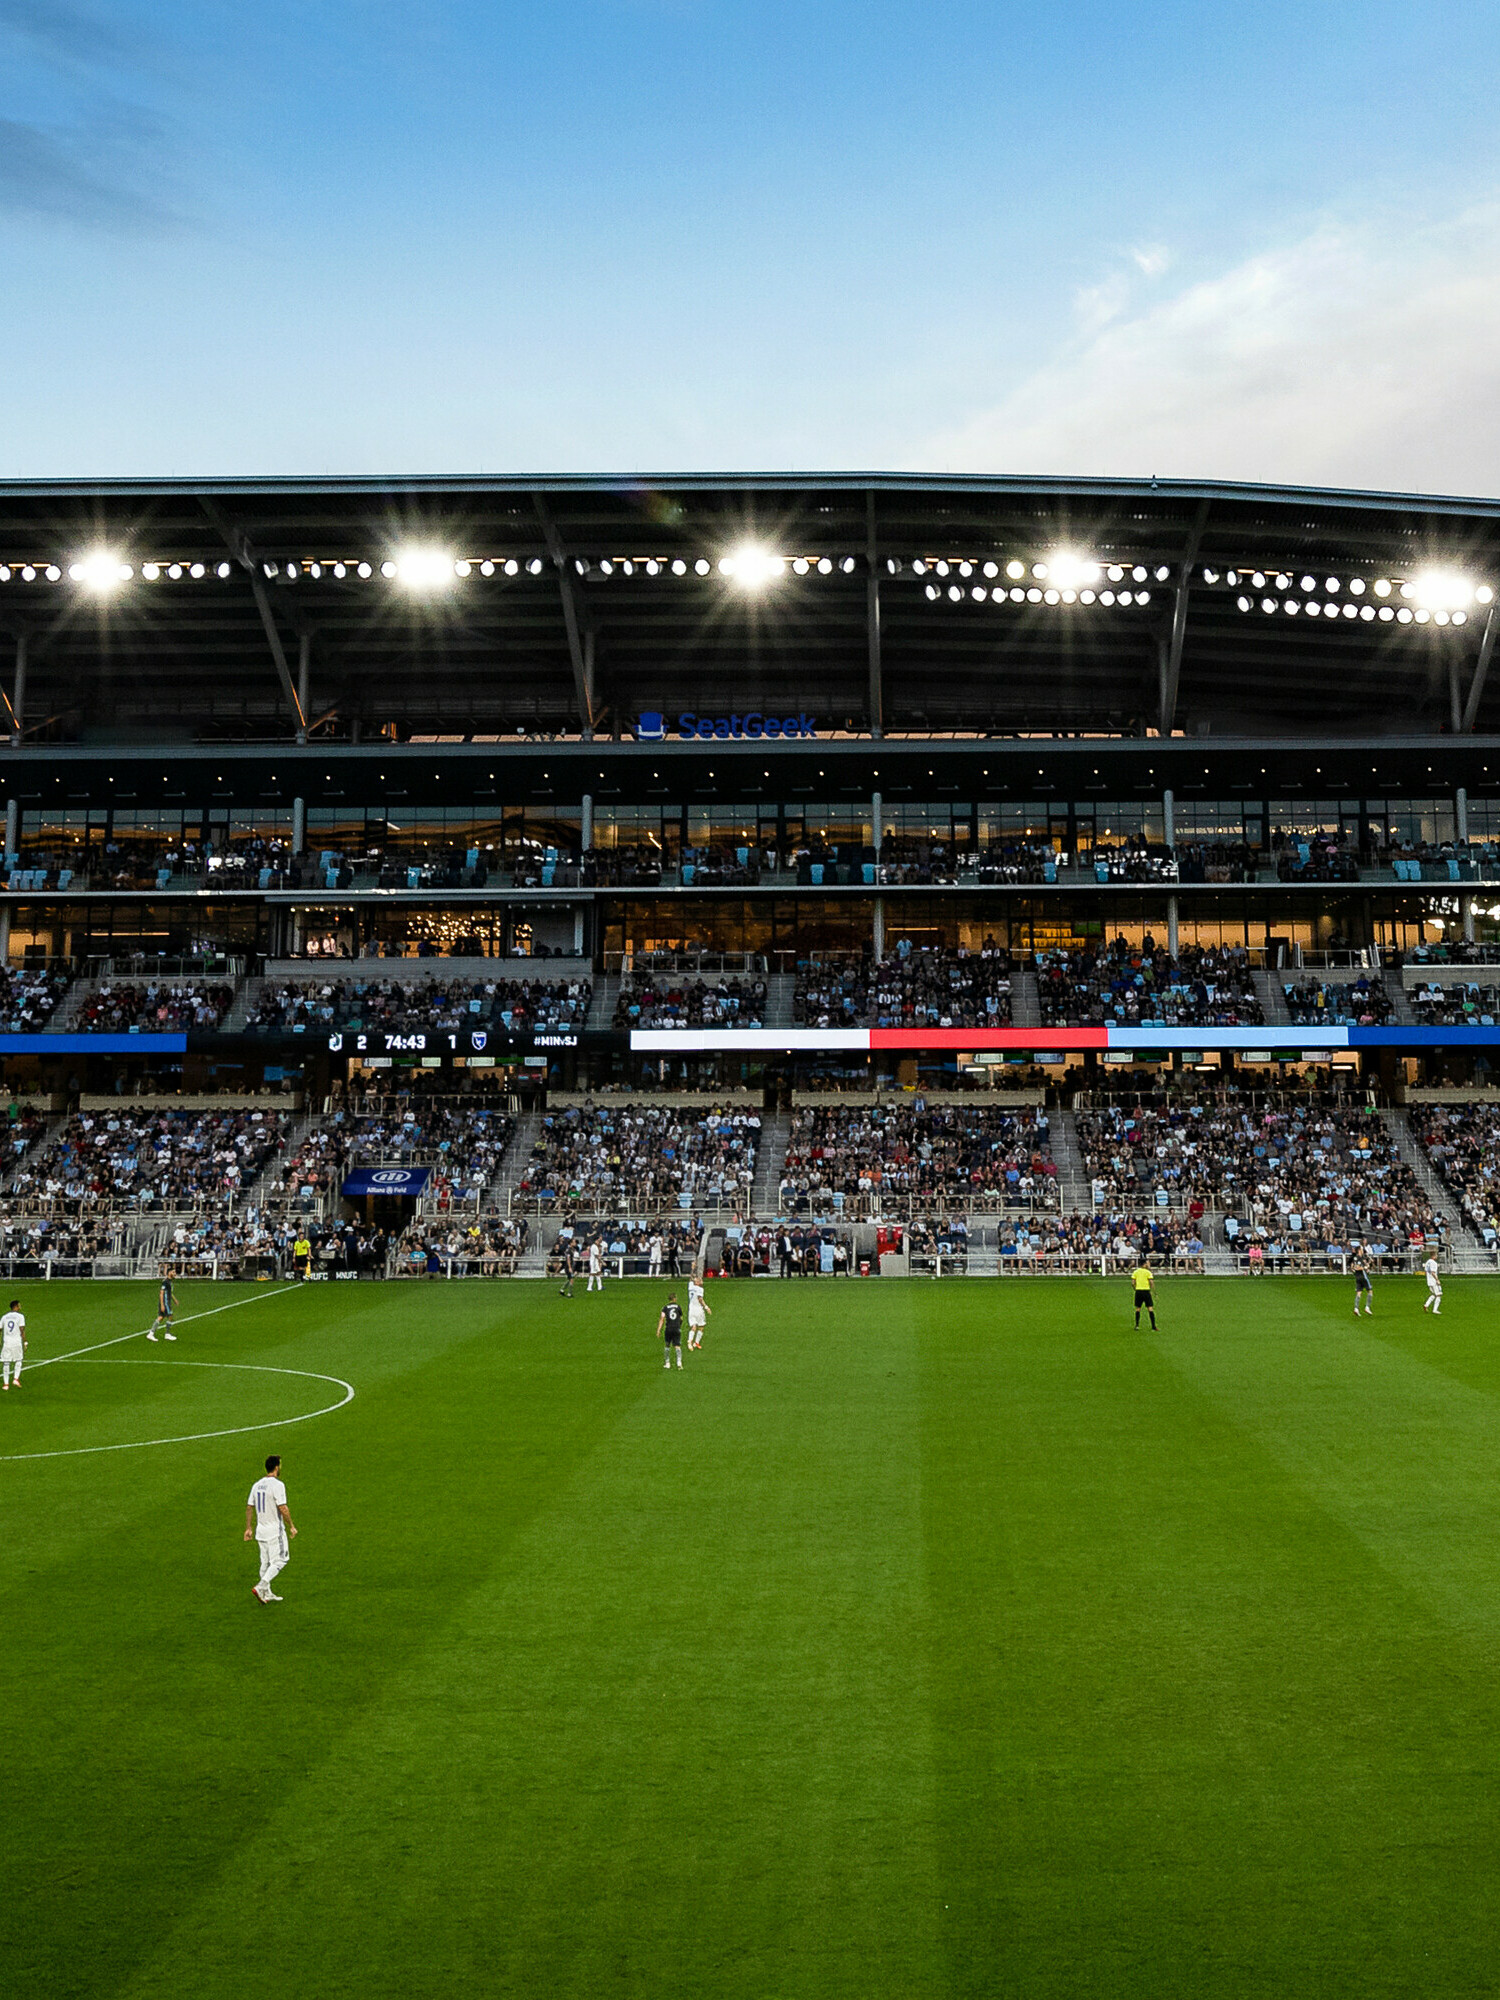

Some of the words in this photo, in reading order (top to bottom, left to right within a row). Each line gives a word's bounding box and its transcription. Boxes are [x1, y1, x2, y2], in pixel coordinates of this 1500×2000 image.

[679, 713, 817, 738] SeatGeek
[357, 1035, 367, 1049] 2
[385, 1035, 426, 1049] 74:43
[448, 1035, 456, 1049] 1
[534, 1036, 577, 1046] #MINvSJ
[670, 1308, 677, 1320] 6
[7, 1320, 15, 1333] 9
[257, 1492, 266, 1513] 11
